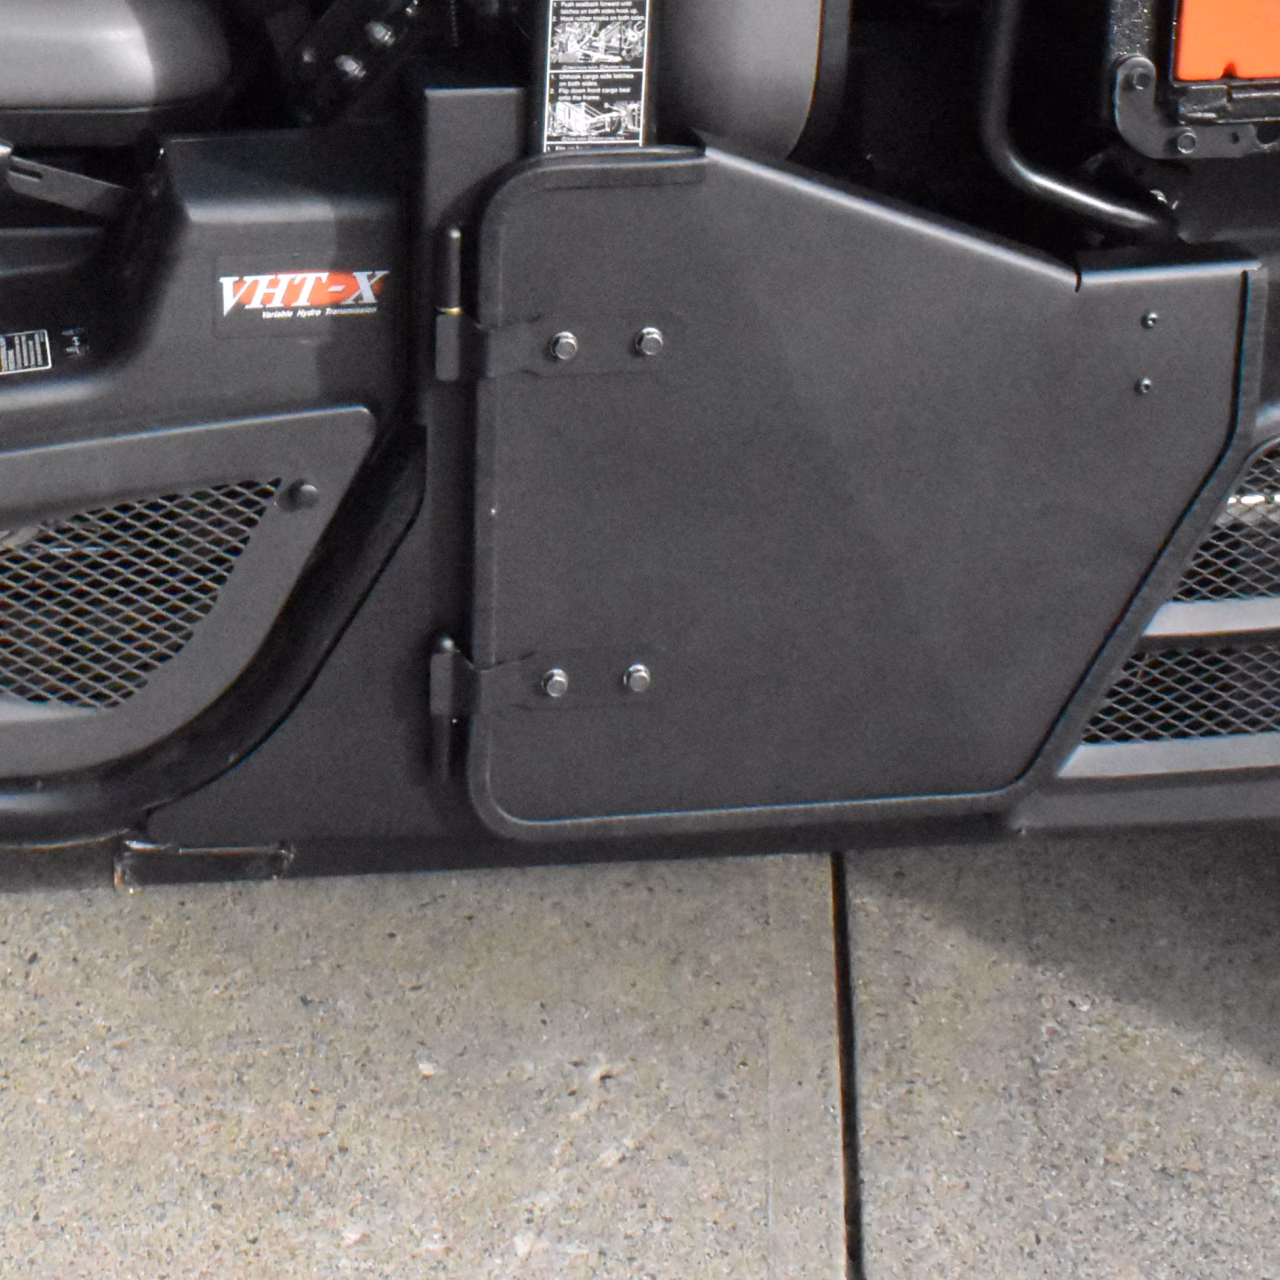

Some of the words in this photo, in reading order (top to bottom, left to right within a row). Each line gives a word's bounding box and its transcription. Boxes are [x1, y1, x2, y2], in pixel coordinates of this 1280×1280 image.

[219, 270, 390, 317] VHT-X
[262, 309, 294, 319] Variable
[296, 309, 322, 318] Hydro
[325, 307, 377, 315] Transmission
